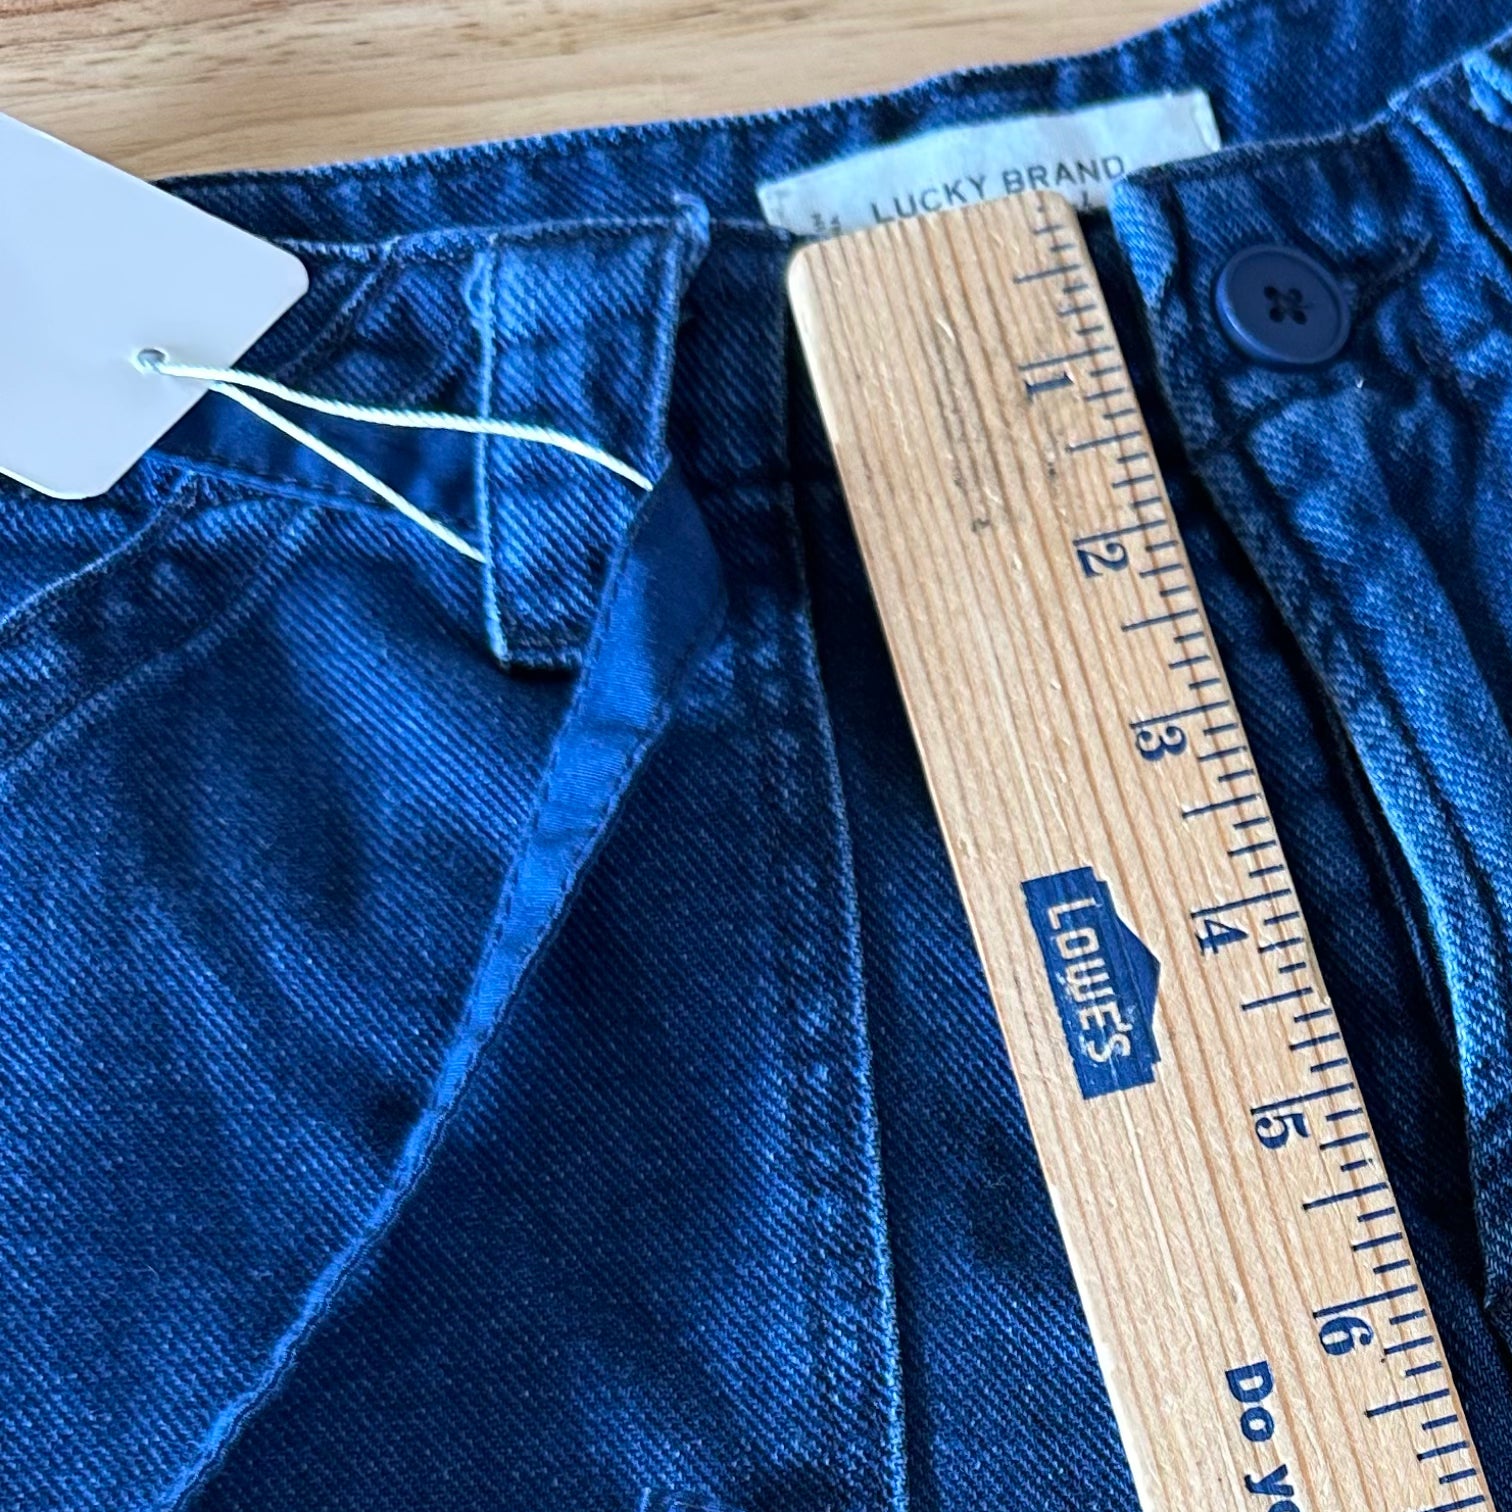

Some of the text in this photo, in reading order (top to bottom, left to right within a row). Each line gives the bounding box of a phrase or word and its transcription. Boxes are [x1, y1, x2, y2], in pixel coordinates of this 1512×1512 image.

[871, 155, 1125, 223] LUCKY BRAND
[1025, 370, 1073, 402] 1
[1076, 542, 1130, 579] 2
[1135, 725, 1188, 761] 3
[1195, 918, 1249, 956] 4
[1255, 1112, 1310, 1150] 5
[1318, 1316, 1374, 1356] 6
[1047, 896, 1133, 1063] LOWE'S
[1225, 1360, 1276, 1442] Do
